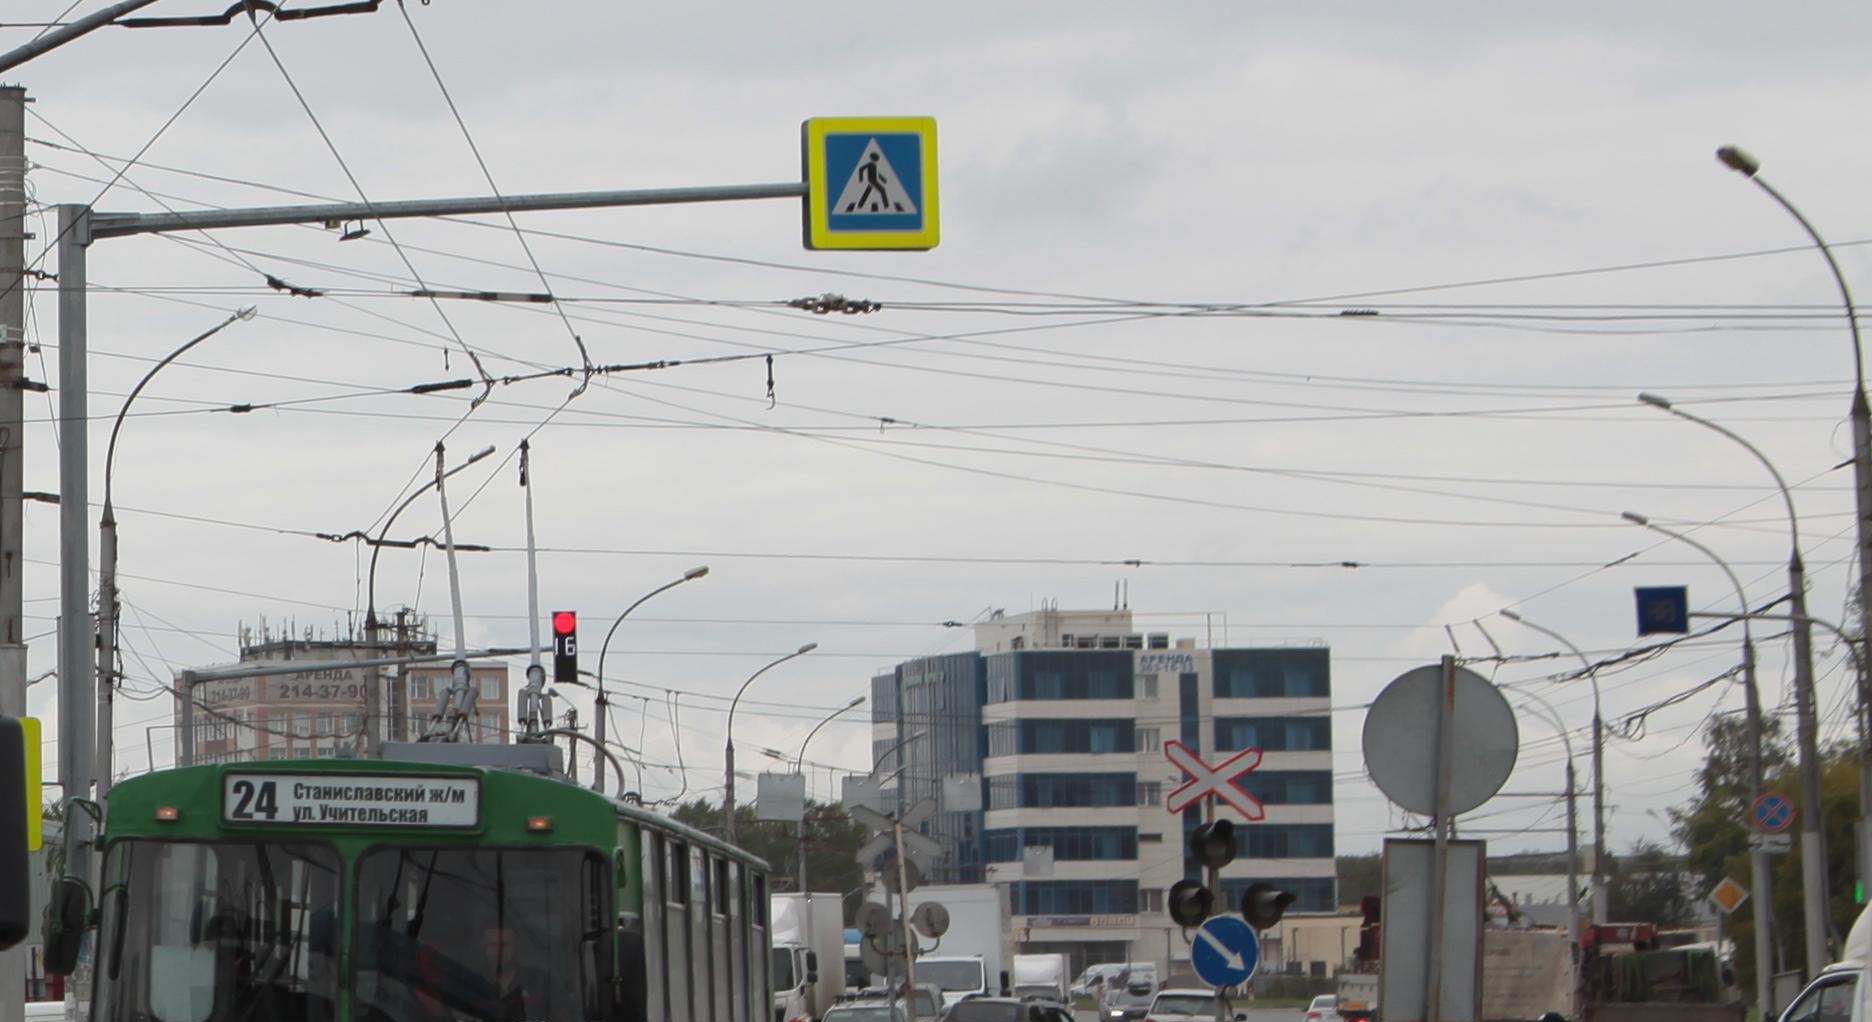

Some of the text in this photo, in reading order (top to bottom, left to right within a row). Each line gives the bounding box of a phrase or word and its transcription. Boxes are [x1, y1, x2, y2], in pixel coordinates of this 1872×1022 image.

[555, 636, 577, 657] 16
[1140, 653, 1193, 663] АРЕНДА
[295, 669, 352, 681] АРЕНДА
[231, 780, 278, 820] 24
[293, 782, 465, 804] Станиславский ж/м
[293, 803, 428, 824] ул. Учительская
